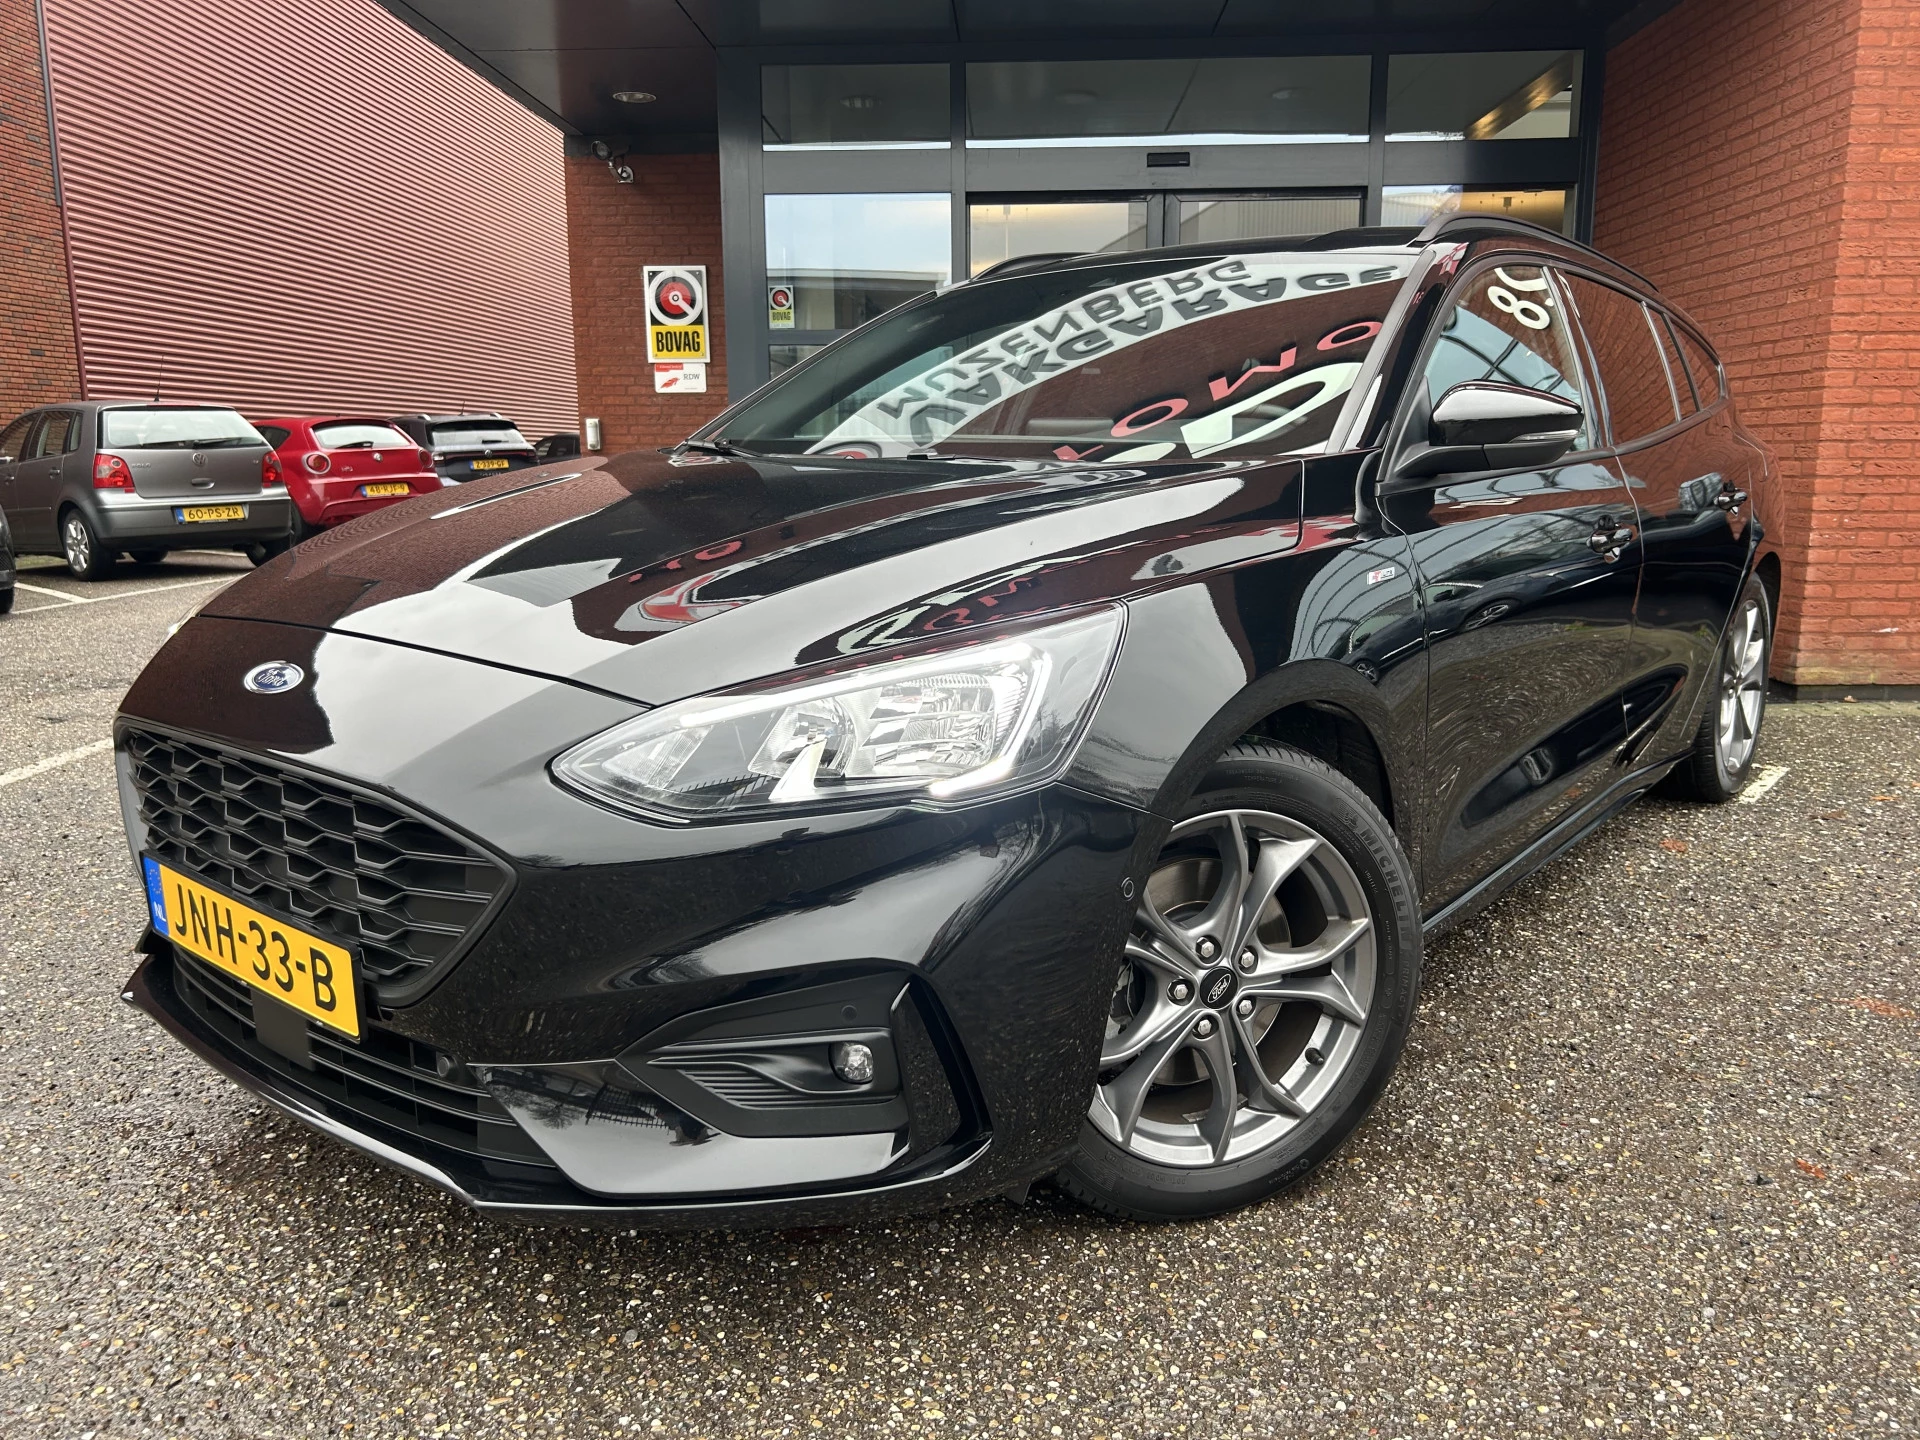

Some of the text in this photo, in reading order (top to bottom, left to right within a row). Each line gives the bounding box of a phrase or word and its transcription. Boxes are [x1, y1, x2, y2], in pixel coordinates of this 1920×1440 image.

[772, 311, 792, 321] BOVAG
[655, 330, 701, 353] BOVAG
[683, 373, 700, 381] RDW
[188, 506, 240, 520] 60-PS-ZR
[1360, 827, 1414, 942] MICHELIN
[153, 901, 167, 923] NL
[175, 882, 337, 1013] JNH-33-B
